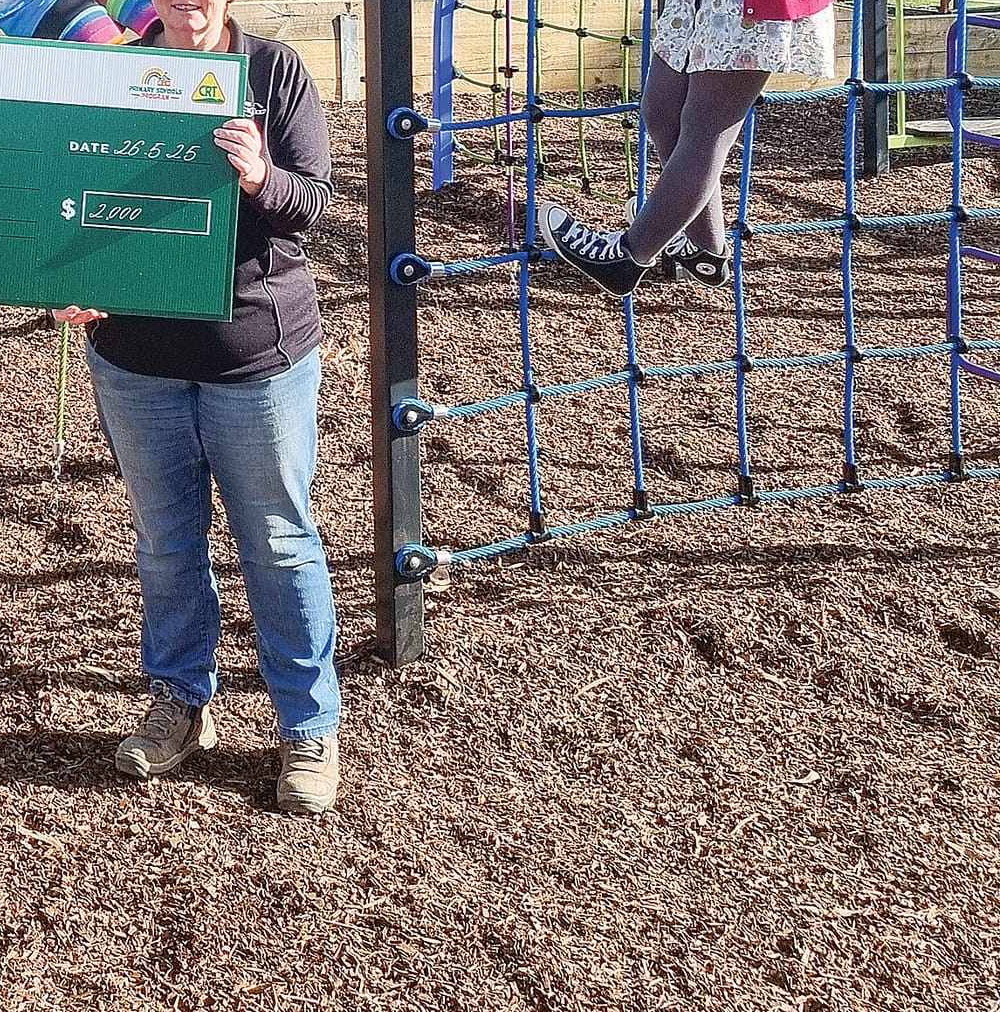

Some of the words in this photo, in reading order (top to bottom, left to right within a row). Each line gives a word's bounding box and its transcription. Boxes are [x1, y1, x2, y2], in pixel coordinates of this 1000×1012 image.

[129, 85, 154, 93] PRIMARY
[155, 87, 182, 95] SCHOOLS
[199, 85, 217, 97] CRT
[69, 141, 110, 154] DATE
[60, 198, 77, 221] $
[88, 203, 142, 221] 2,000
